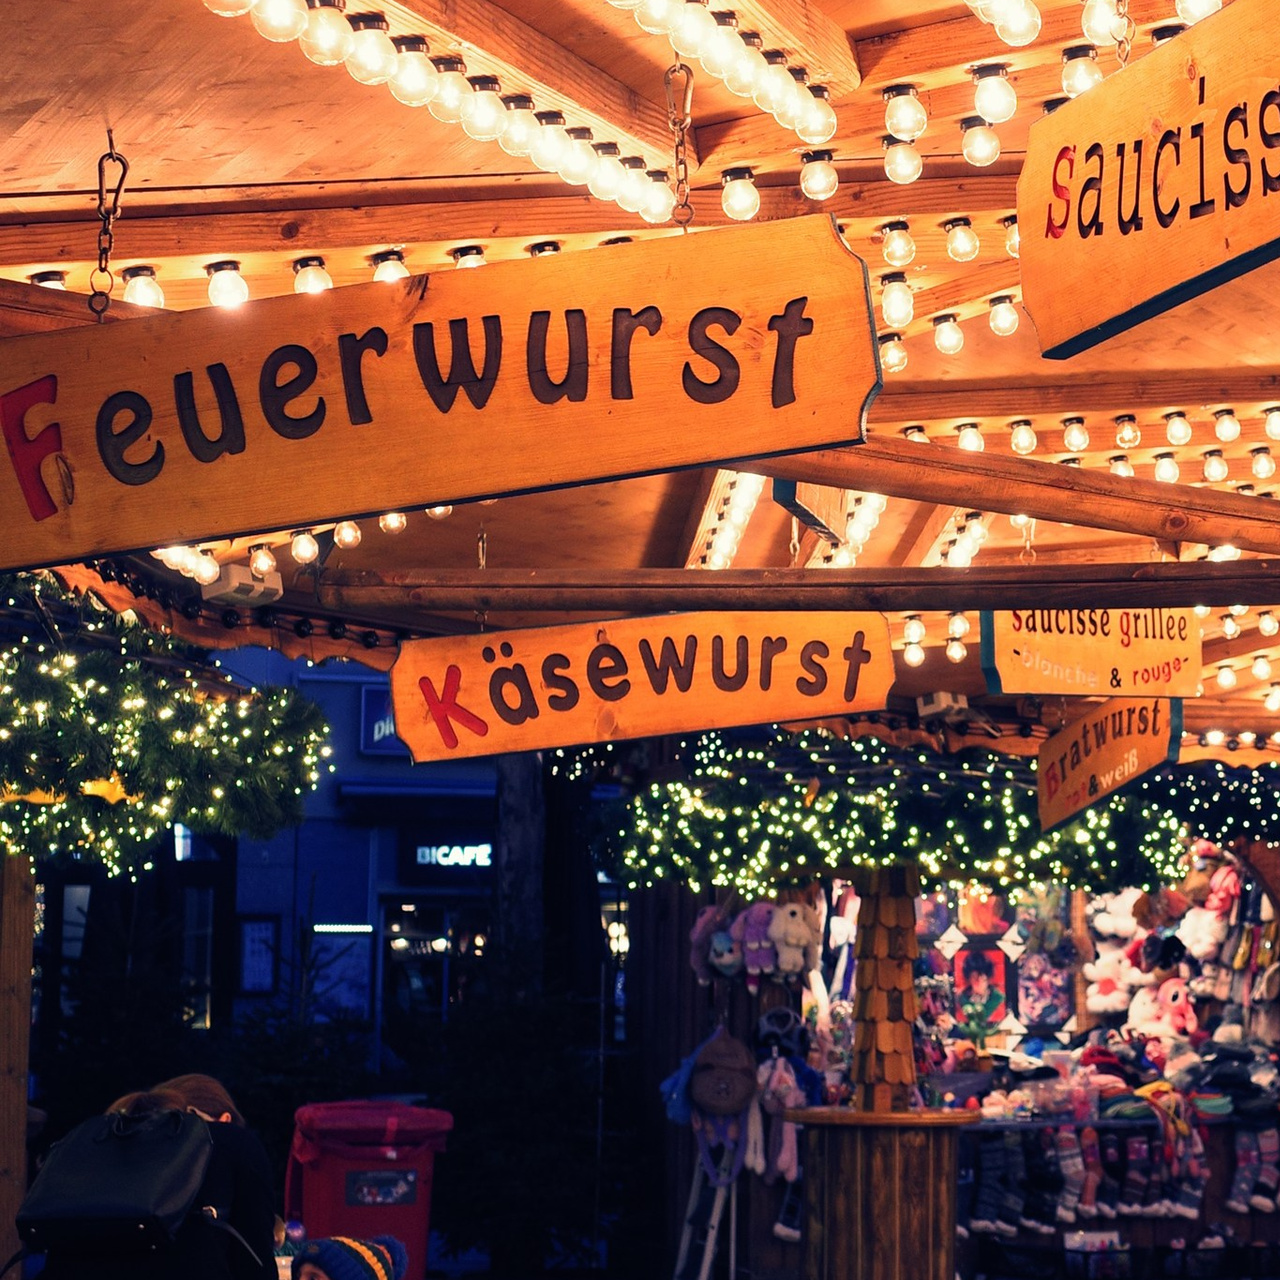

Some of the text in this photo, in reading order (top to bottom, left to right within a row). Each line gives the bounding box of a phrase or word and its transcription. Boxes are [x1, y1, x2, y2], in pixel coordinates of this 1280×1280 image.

[0, 296, 814, 522] Feuerwurst
[1012, 609, 1110, 637] saucisse
[419, 630, 872, 752] Käsewurst
[1110, 668, 1121, 688] &
[1045, 698, 1160, 801] Bratwurst
[1088, 774, 1098, 797] &
